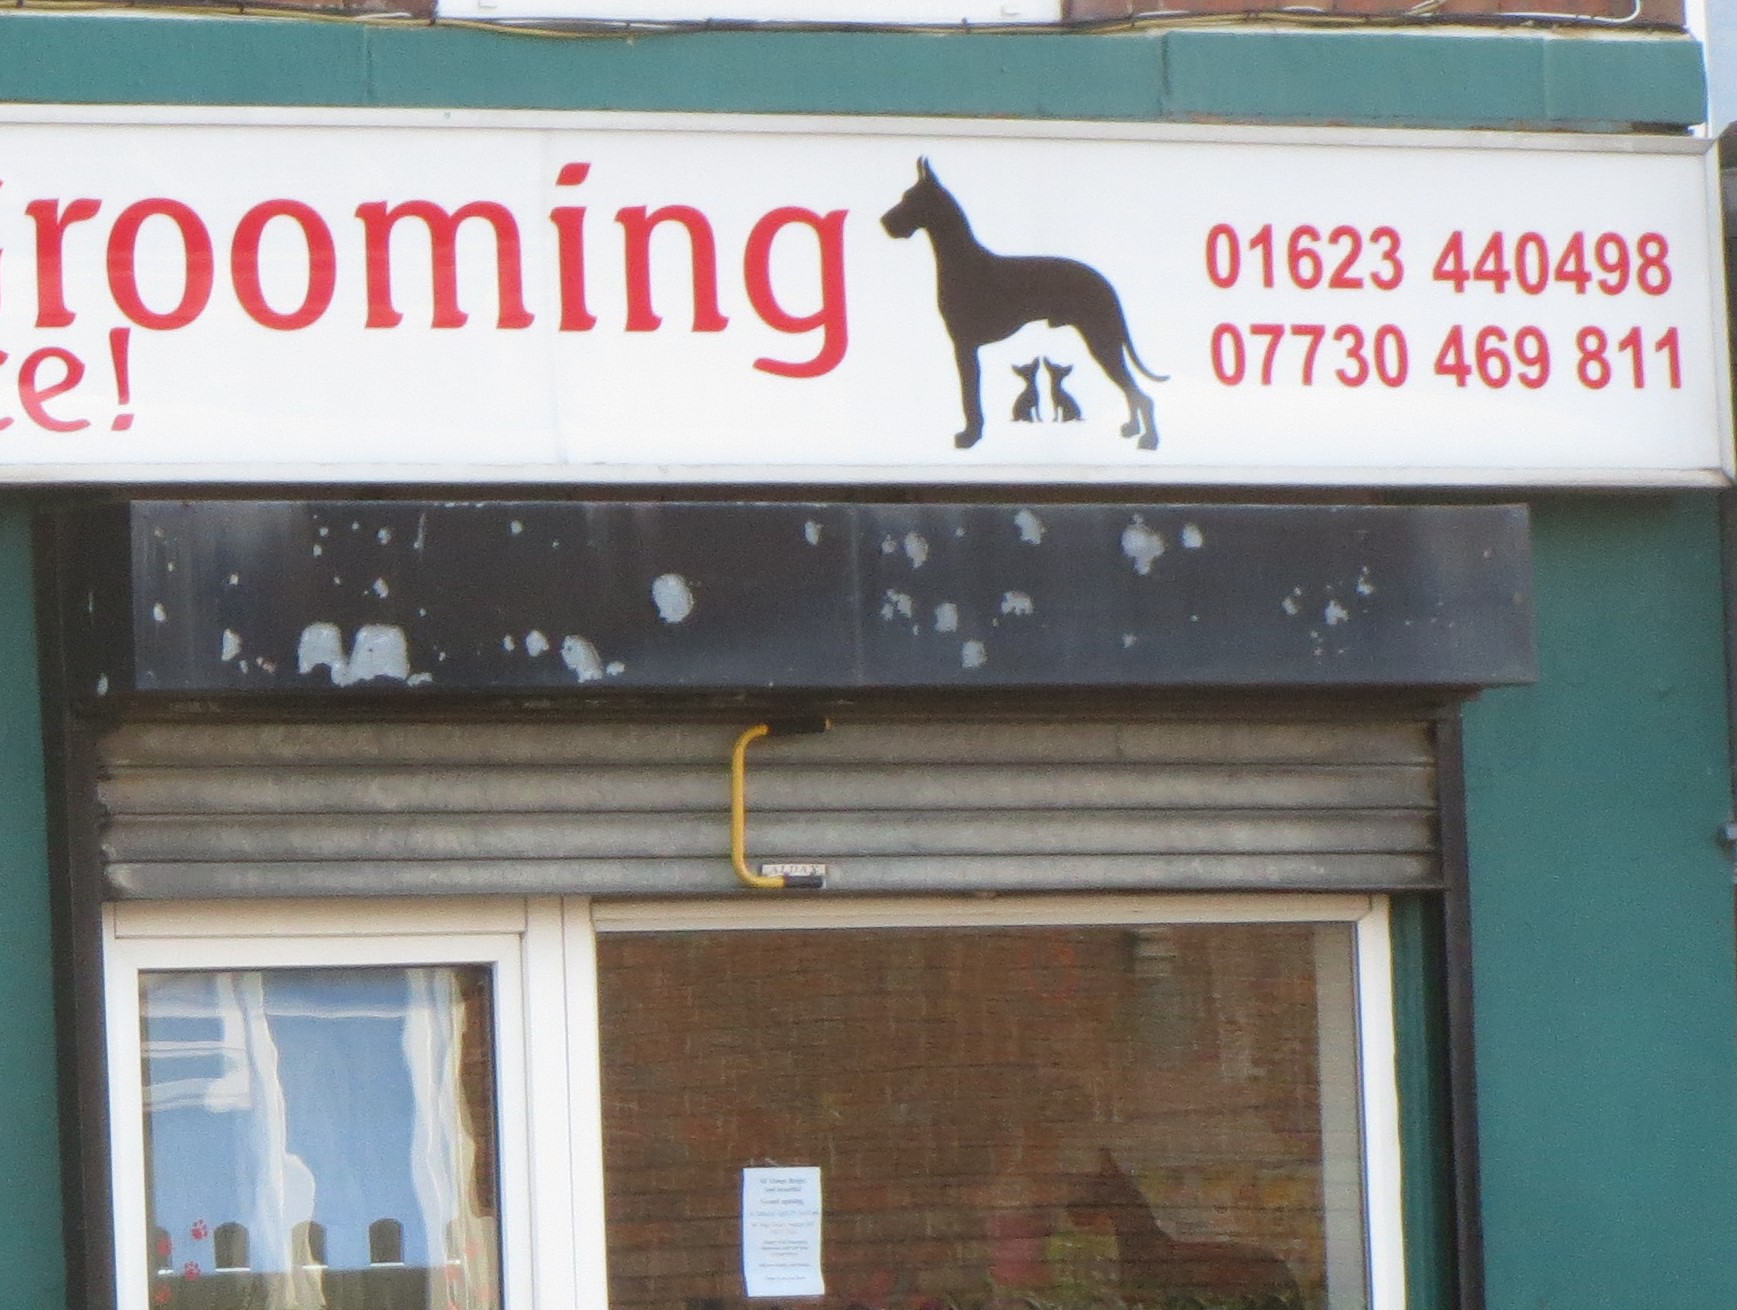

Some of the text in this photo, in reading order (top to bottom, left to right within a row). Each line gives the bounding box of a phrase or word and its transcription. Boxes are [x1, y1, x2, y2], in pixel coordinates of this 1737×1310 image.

[1205, 223, 1673, 297] 01623 440498
[1210, 322, 1683, 391] 07730 469 811
